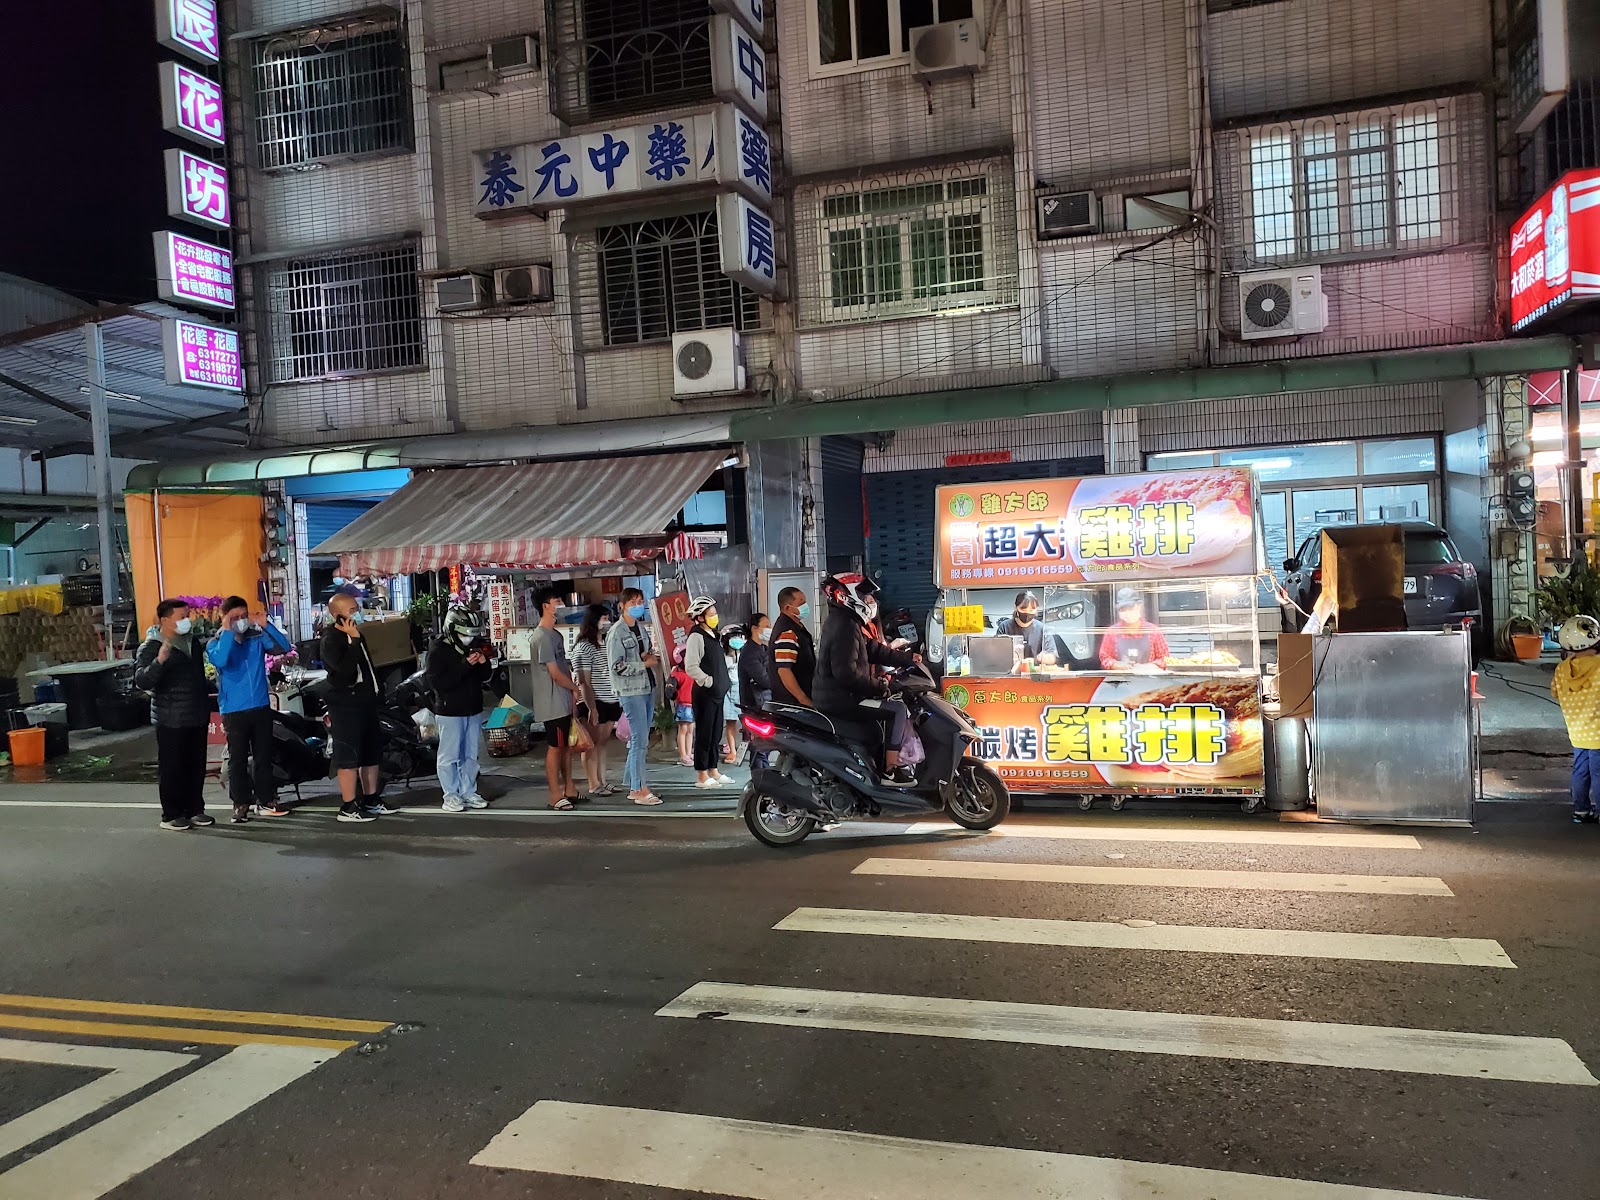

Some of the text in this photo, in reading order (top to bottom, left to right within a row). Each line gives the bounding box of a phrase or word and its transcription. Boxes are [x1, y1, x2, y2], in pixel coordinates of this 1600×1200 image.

[478, 121, 716, 207] 泰元中藥
[198, 348, 236, 364] 6317273
[198, 360, 237, 375] 6319877
[200, 371, 238, 386] 6310067
[984, 502, 1195, 559] 超大 雞排
[951, 564, 1073, 579] 服務專線 0919616559
[1046, 706, 1222, 762] 雞排
